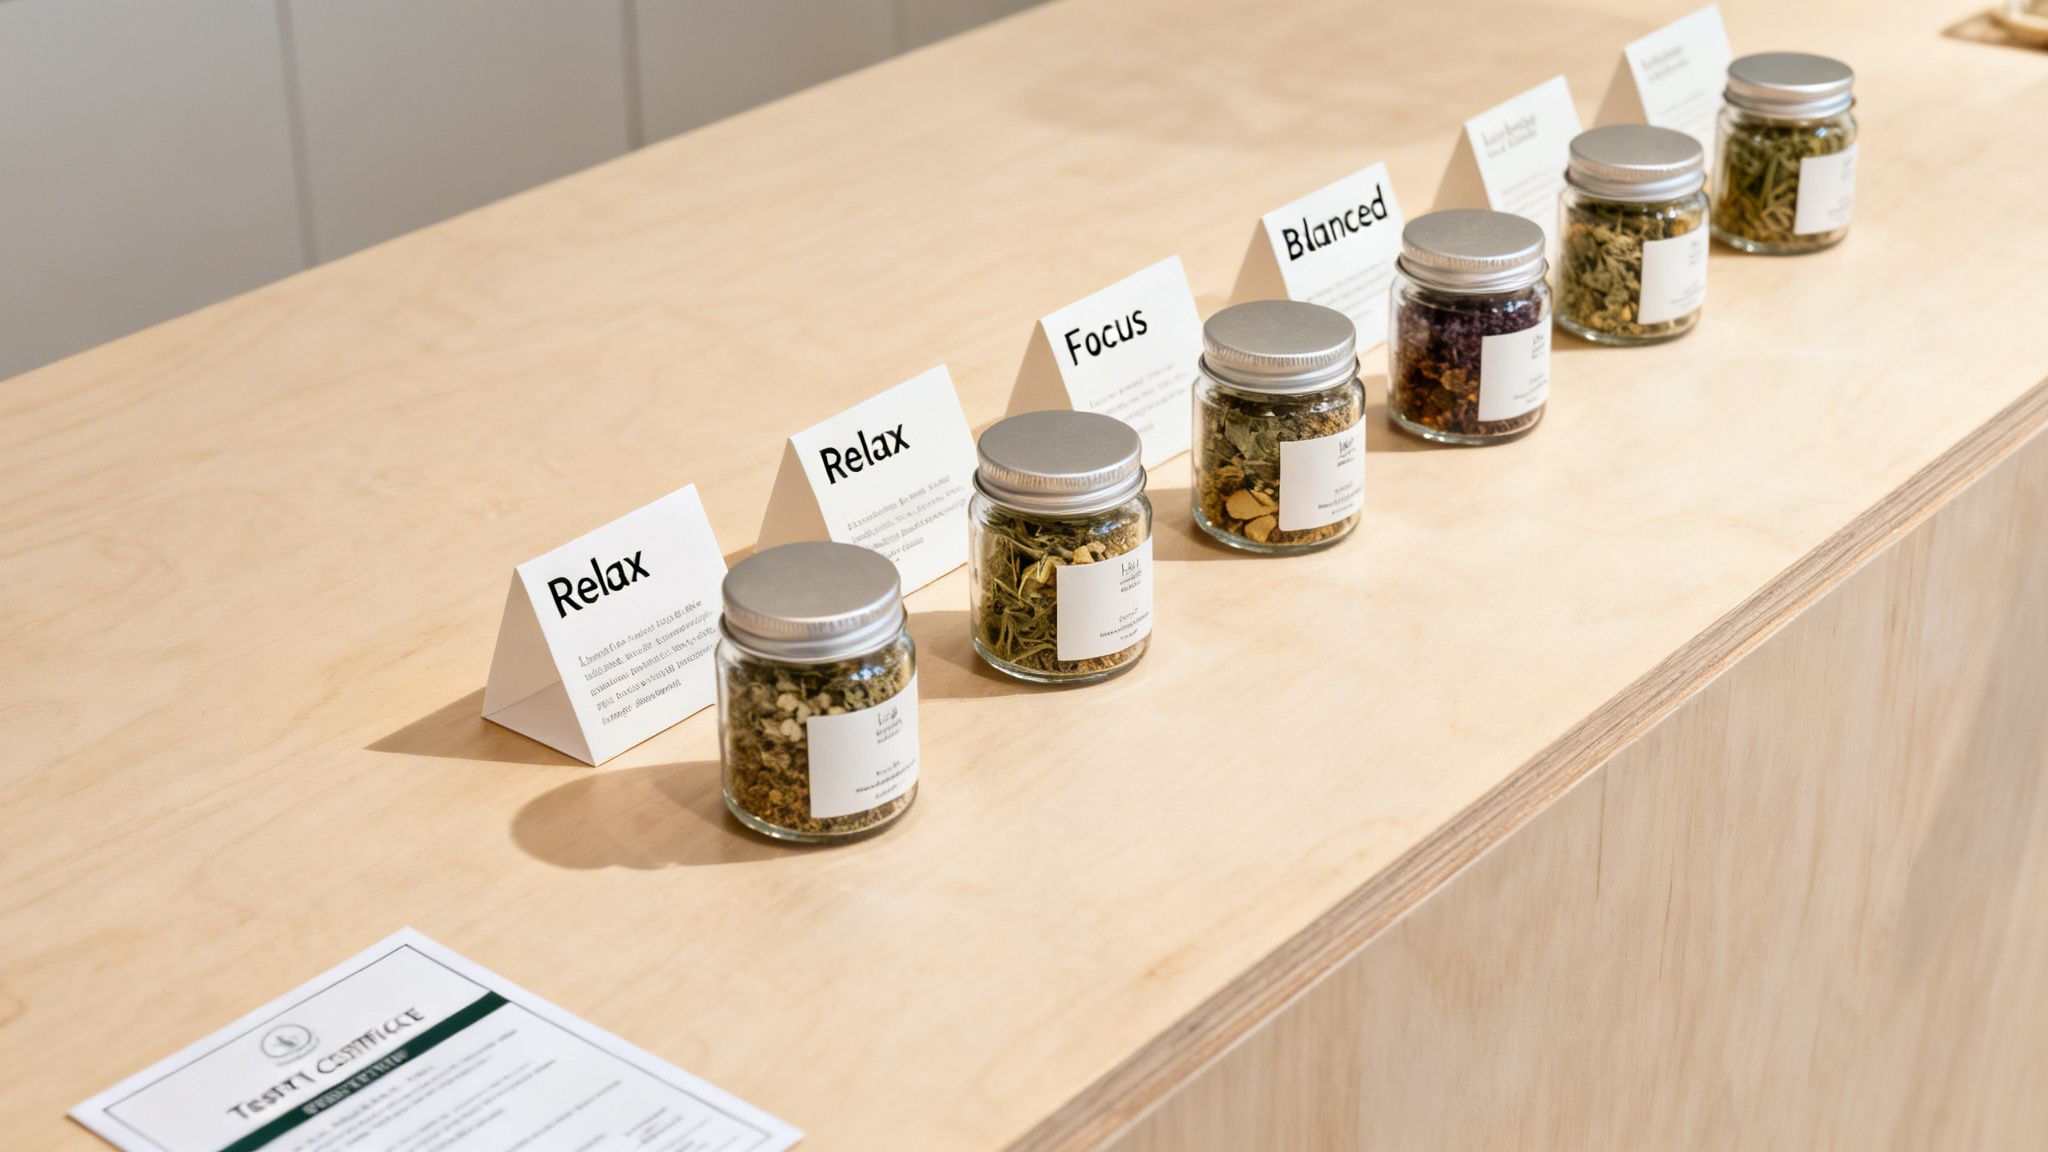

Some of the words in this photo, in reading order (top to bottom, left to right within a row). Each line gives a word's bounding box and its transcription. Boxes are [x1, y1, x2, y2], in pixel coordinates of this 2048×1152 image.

[1283, 185, 1387, 260] Blanced
[1065, 311, 1147, 366] Focus
[820, 424, 910, 484] Relax
[548, 551, 650, 618] Relax
